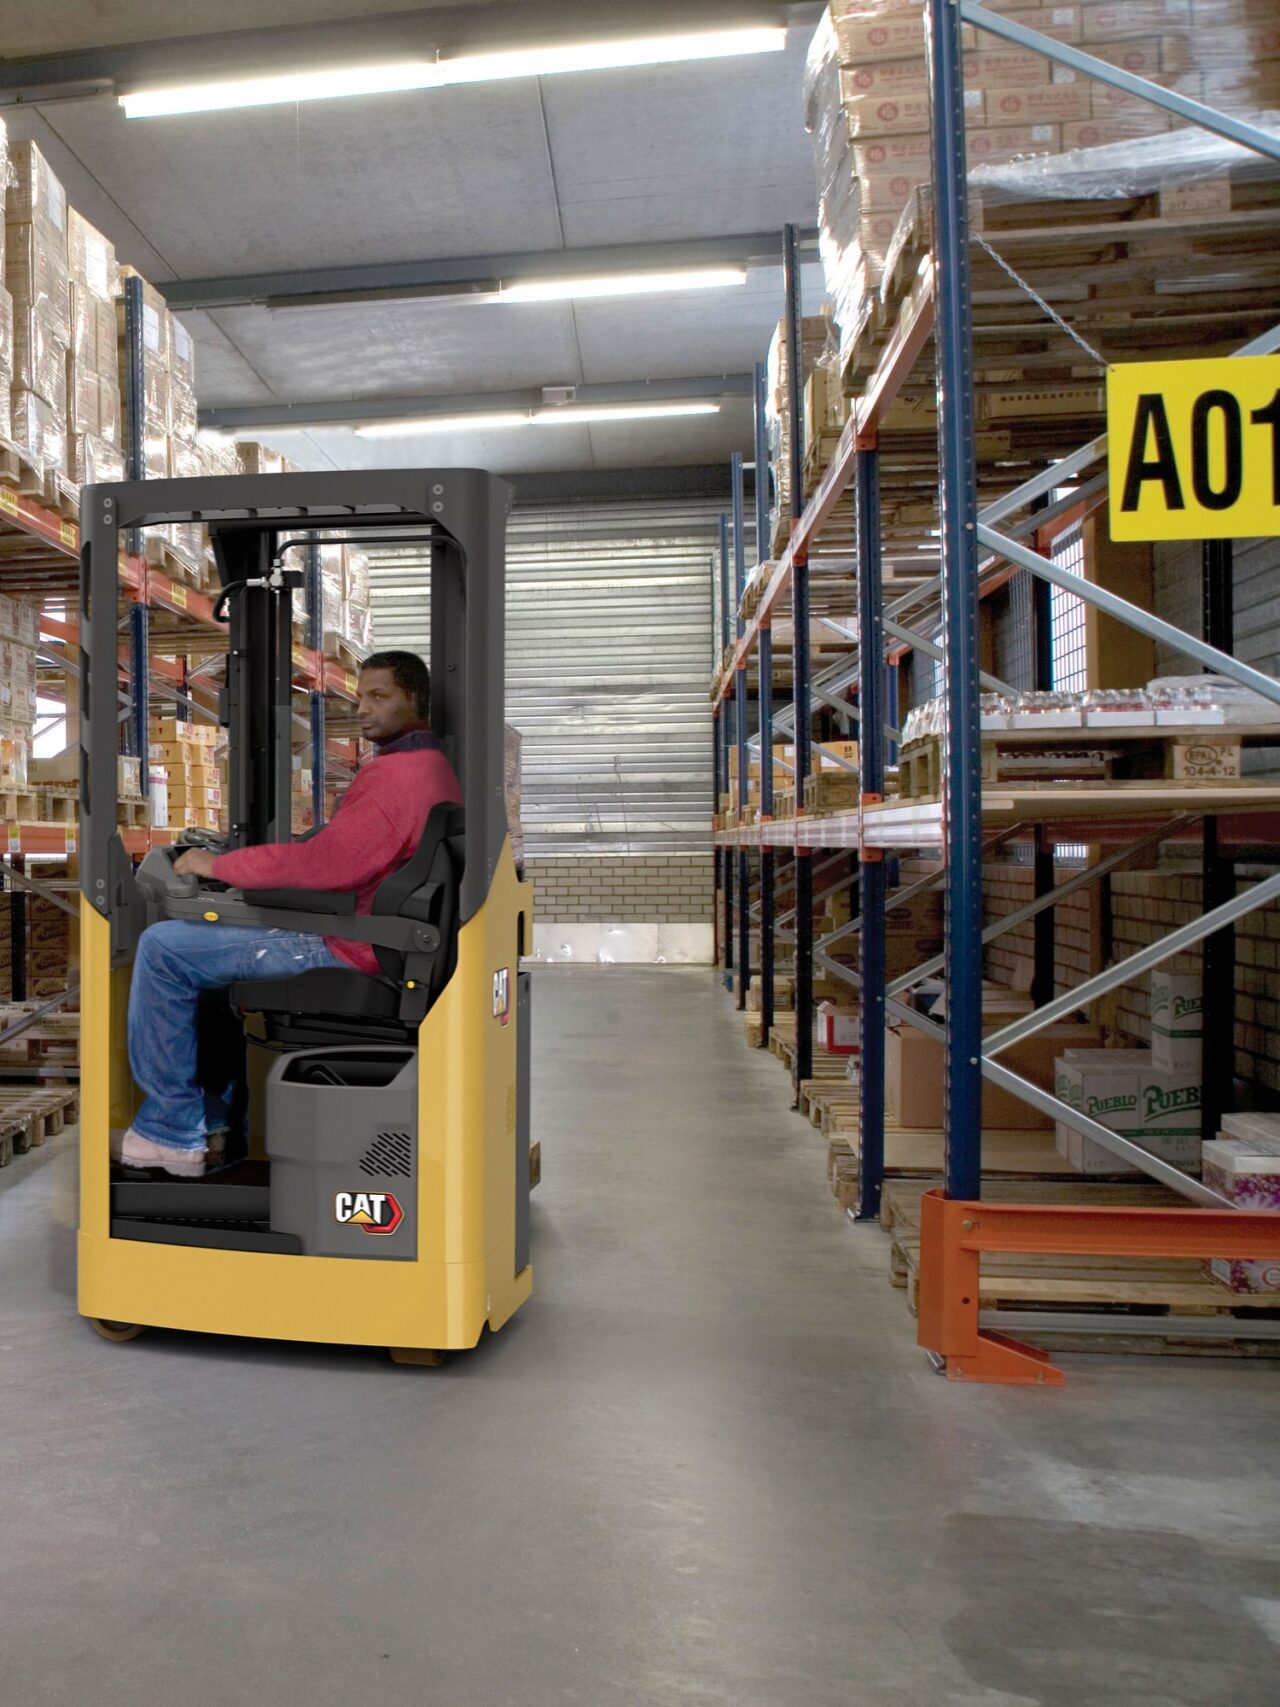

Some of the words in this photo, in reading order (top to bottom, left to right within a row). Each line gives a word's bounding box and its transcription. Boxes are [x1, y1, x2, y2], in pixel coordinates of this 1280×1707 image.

[1121, 388, 1280, 512] A01
[1087, 1094, 1137, 1114] PUEBLO
[1143, 1085, 1202, 1116] PUEB
[336, 1192, 386, 1224] CAT
